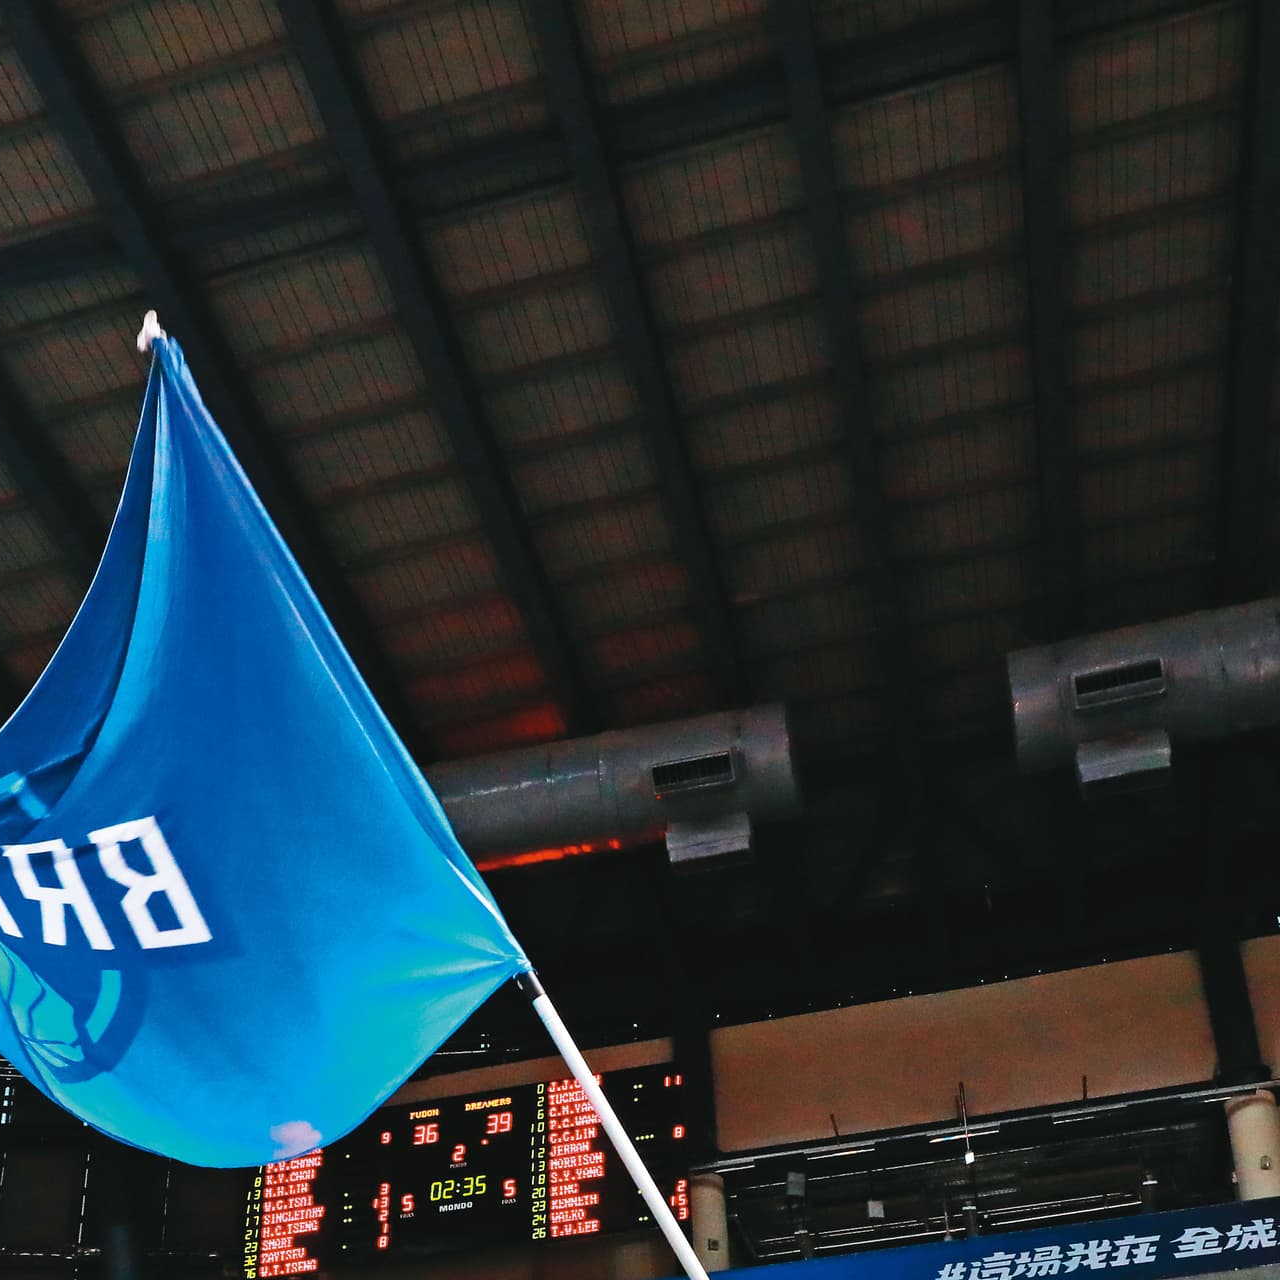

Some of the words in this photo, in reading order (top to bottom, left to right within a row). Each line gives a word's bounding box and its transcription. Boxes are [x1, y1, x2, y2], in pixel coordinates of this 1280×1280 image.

[465, 1098, 511, 1111] DREAMERS
[537, 1097, 544, 1107] 2
[538, 1109, 544, 1119] 6
[486, 1112, 512, 1134] 39
[531, 1122, 544, 1133] 10
[381, 1132, 391, 1144] 9
[413, 1124, 439, 1145] 36
[674, 1127, 682, 1138] 8
[452, 1145, 465, 1161] 2
[531, 1148, 545, 1159] 12
[532, 1161, 545, 1172] 13
[550, 1153, 603, 1170] MORRISON
[254, 1177, 261, 1187] 8
[532, 1174, 545, 1185] 18
[380, 1184, 390, 1195] 3
[430, 1175, 486, 1200] 02:35
[503, 1179, 516, 1196] 5
[532, 1187, 546, 1199] 20
[551, 1184, 578, 1197] KING
[677, 1180, 686, 1192] 2
[247, 1190, 261, 1200] 13
[373, 1197, 390, 1208] 13
[401, 1195, 414, 1211] 5
[439, 1202, 473, 1212] MONDO
[532, 1200, 546, 1212] 23
[551, 1194, 597, 1210] KENNETH
[671, 1194, 687, 1206] 15
[247, 1203, 260, 1214] 14
[246, 1216, 260, 1226] 17
[263, 1207, 324, 1225] SINGLETARY
[379, 1210, 389, 1221] 2
[532, 1214, 546, 1226] 24
[679, 1208, 687, 1219] 3
[245, 1229, 259, 1240] 21
[532, 1228, 546, 1240] 26
[245, 1242, 258, 1253] 23
[262, 1238, 292, 1250] SMART
[378, 1236, 388, 1248] 8
[244, 1255, 257, 1266] 32
[244, 1269, 256, 1279] 76
